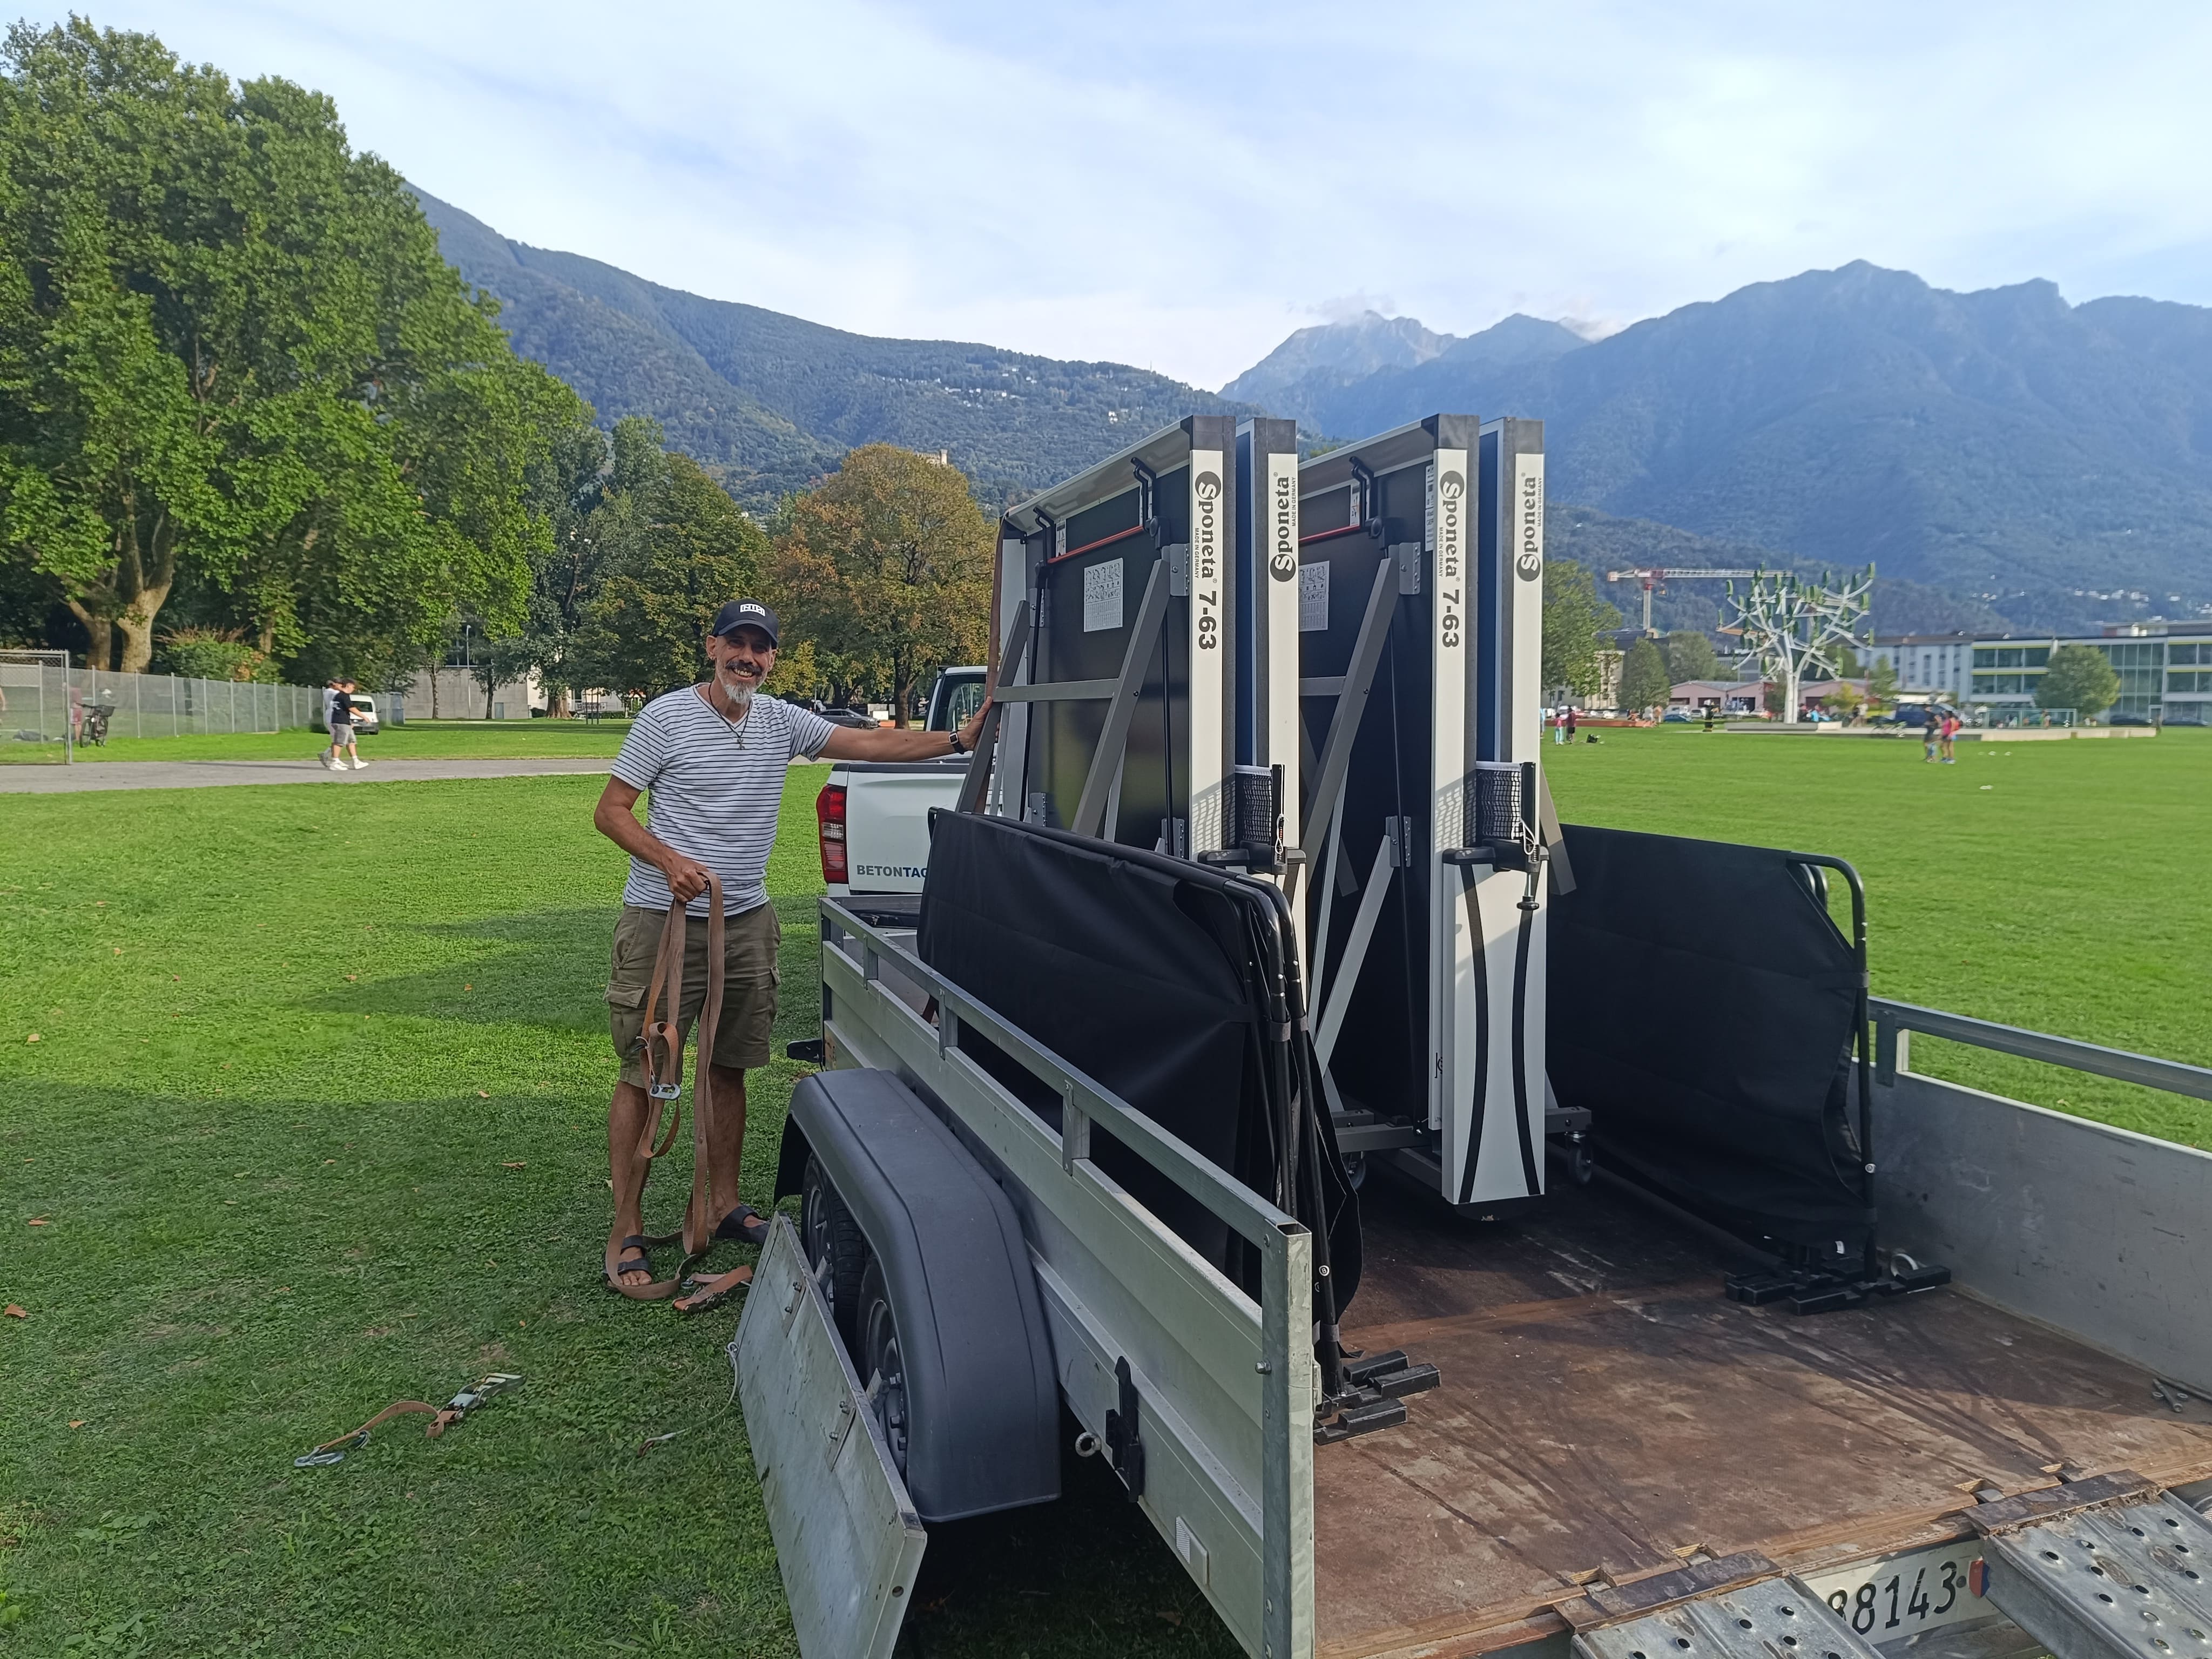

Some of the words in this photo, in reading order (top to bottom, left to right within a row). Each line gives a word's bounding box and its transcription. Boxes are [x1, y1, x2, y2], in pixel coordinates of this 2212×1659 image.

[1195, 471, 1221, 579] Sponeta
[1270, 477, 1296, 582] Sponeta
[1439, 470, 1465, 577] Sponeta
[1516, 477, 1541, 582] Sponeta
[1198, 590, 1217, 650] 7-63
[1442, 589, 1459, 648] 7-63
